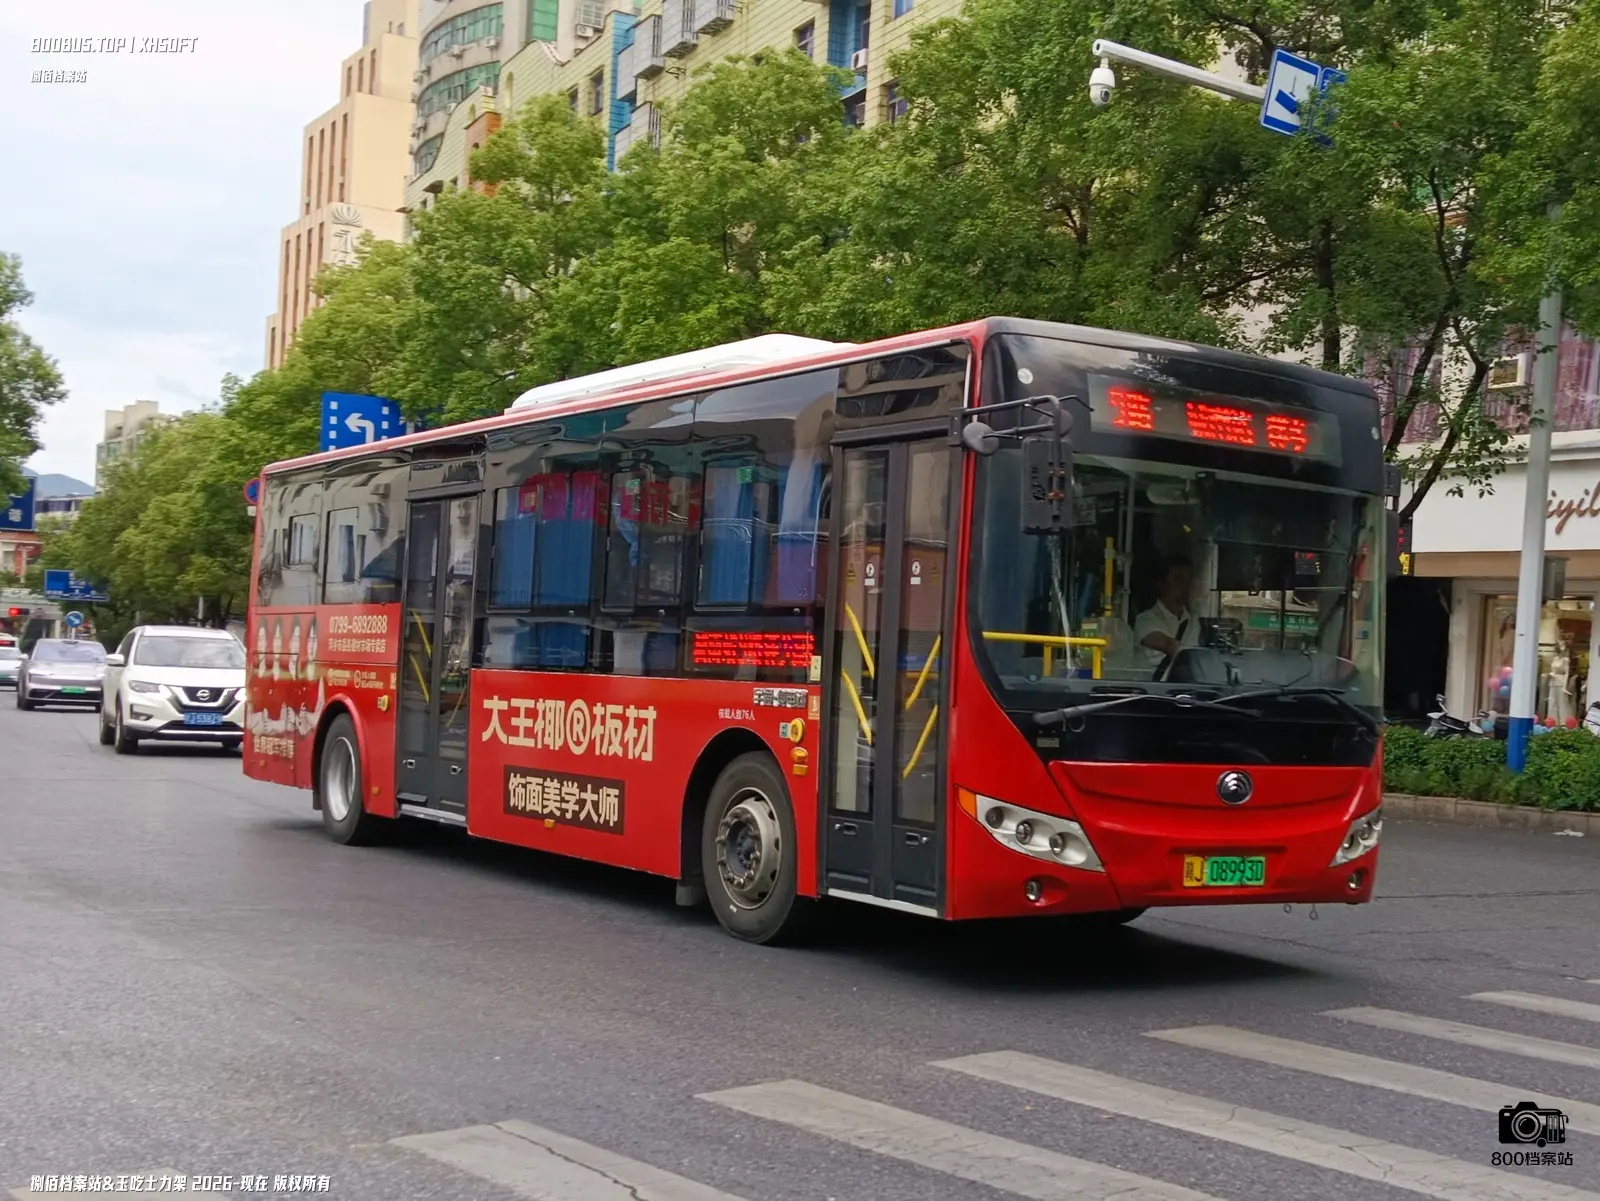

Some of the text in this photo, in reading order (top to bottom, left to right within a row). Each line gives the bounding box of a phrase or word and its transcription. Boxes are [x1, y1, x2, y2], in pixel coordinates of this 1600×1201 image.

[508, 772, 620, 827] 饰面美学大师
